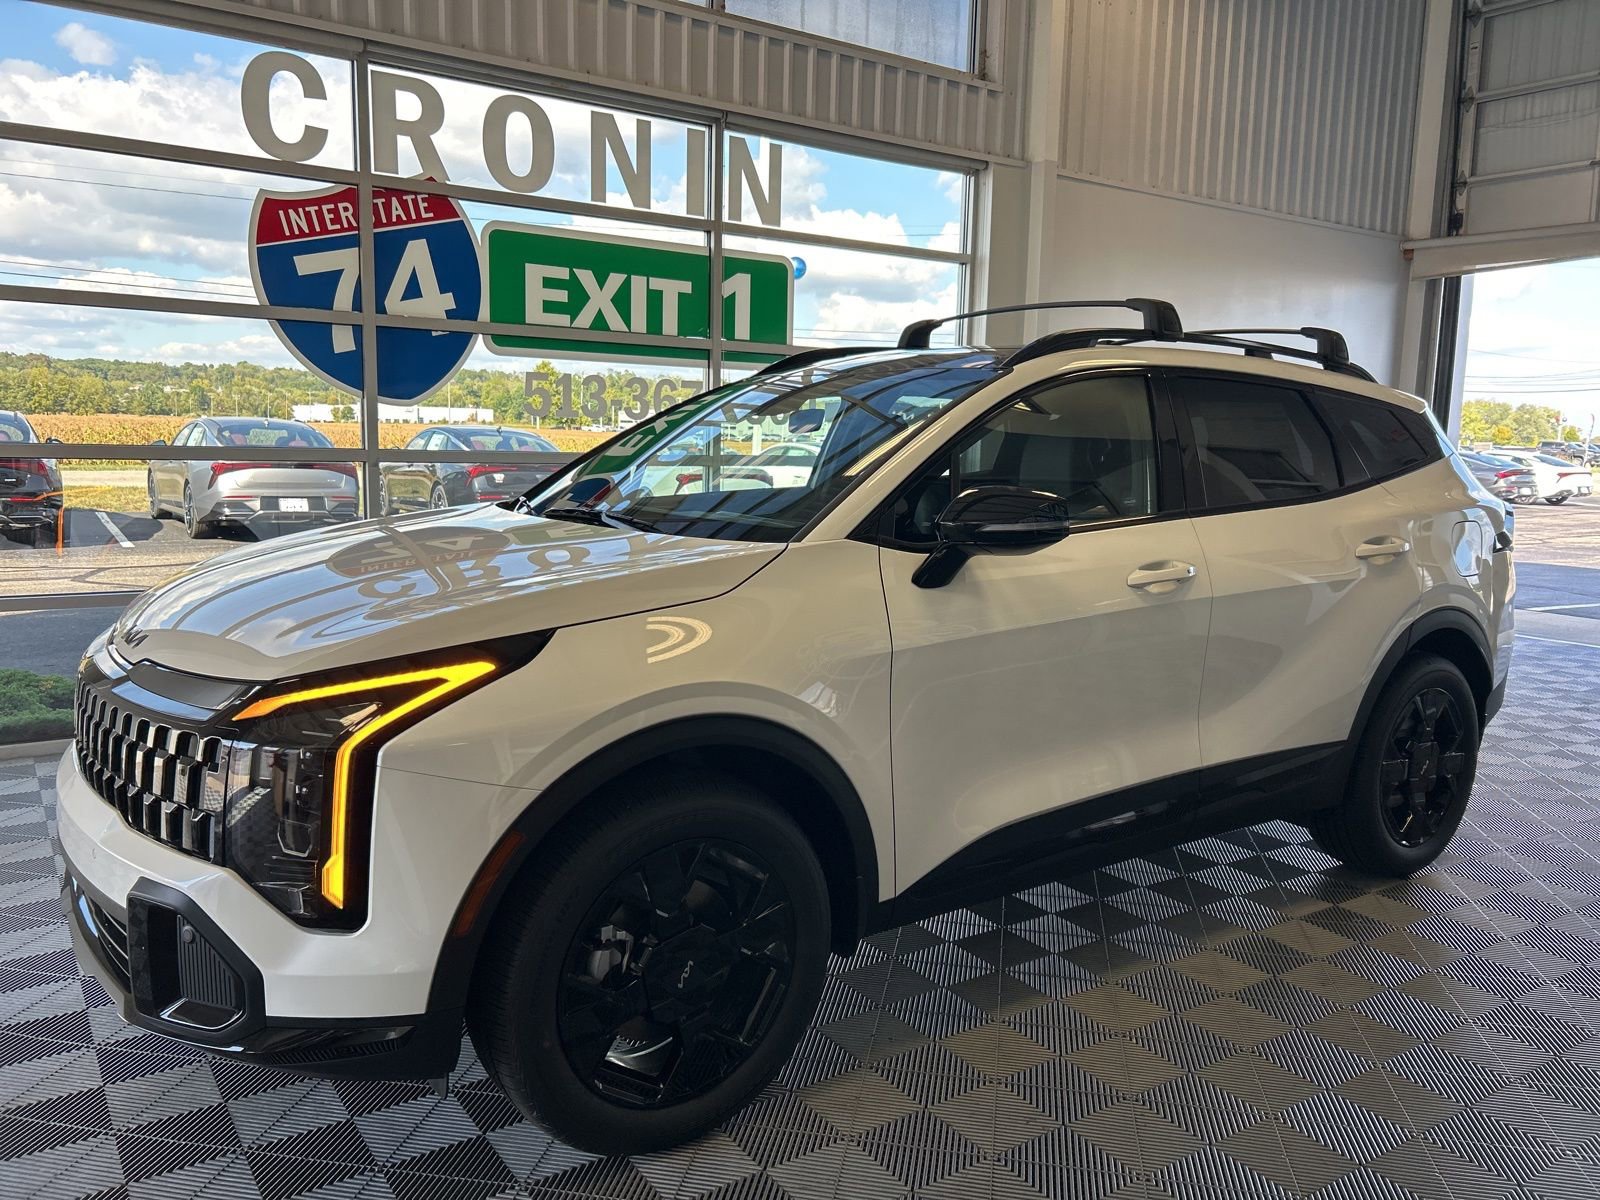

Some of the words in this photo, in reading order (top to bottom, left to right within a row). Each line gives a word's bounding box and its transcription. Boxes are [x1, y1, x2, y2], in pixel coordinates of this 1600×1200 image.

[241, 51, 783, 227] CRONIN
[278, 194, 434, 236] INTERTATE
[293, 238, 456, 353] 74
[525, 263, 692, 336] EXIT
[721, 272, 751, 341] 1
